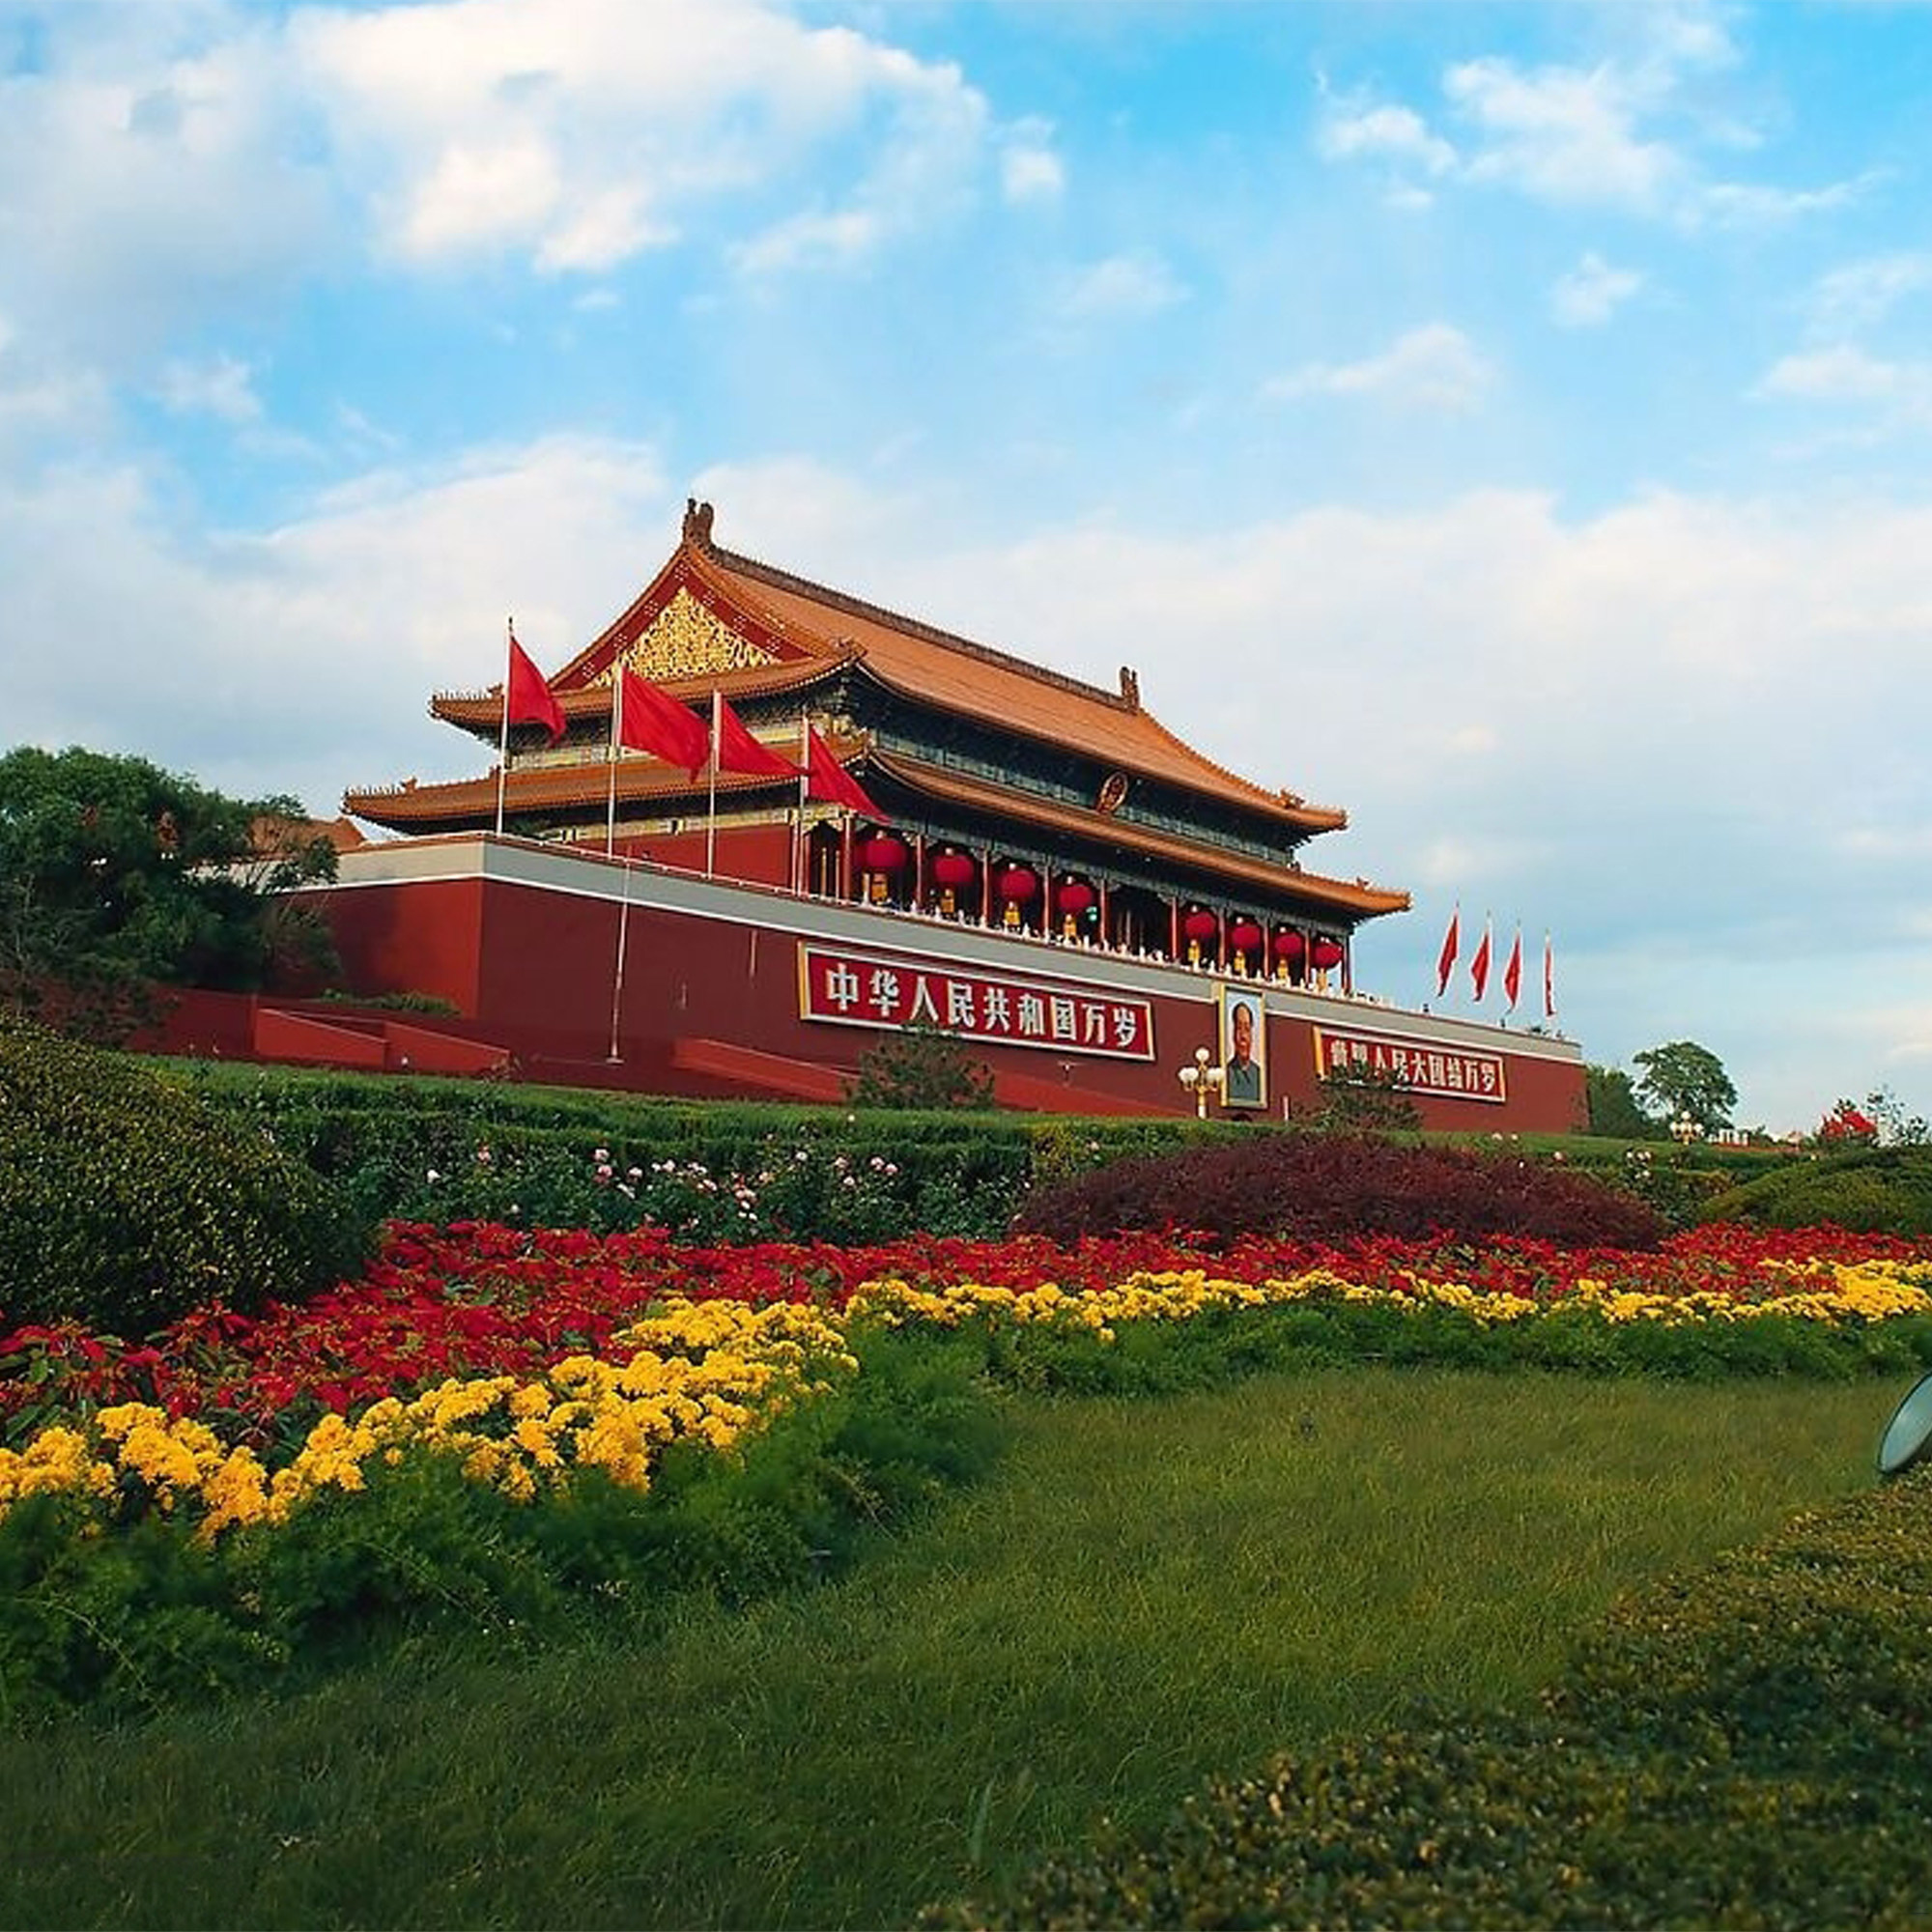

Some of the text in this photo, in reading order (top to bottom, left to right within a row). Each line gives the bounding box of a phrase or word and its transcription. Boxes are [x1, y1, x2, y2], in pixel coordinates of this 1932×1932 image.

[826, 962, 1137, 1048] 中华人民共和国万岁
